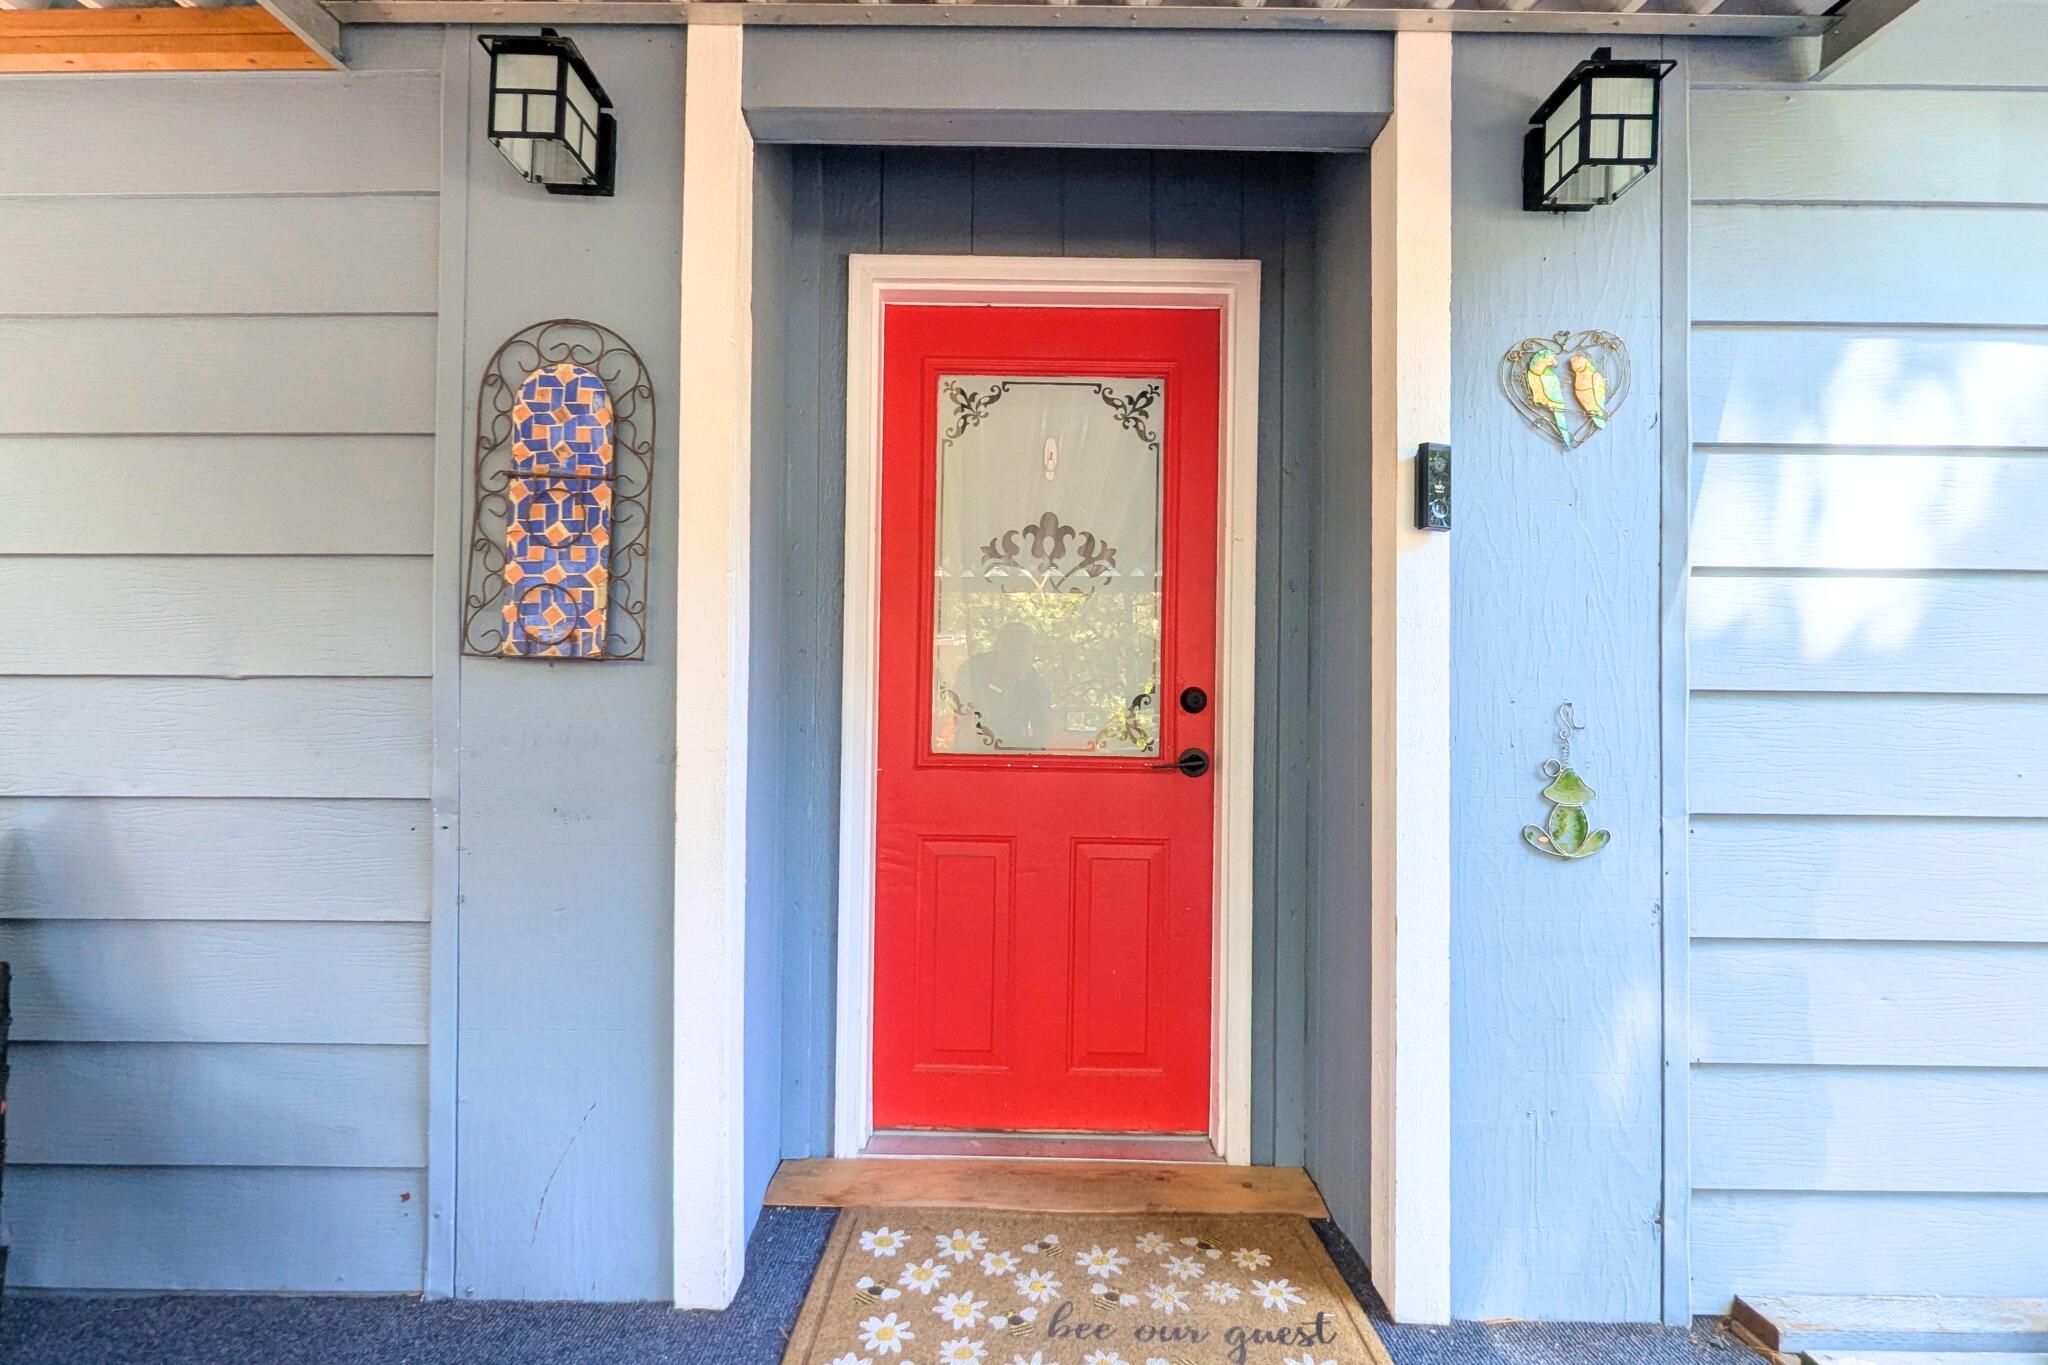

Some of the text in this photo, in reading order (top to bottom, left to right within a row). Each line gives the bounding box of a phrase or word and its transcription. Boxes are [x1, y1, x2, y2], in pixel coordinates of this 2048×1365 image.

[1048, 1301, 1337, 1364] bee our guest
